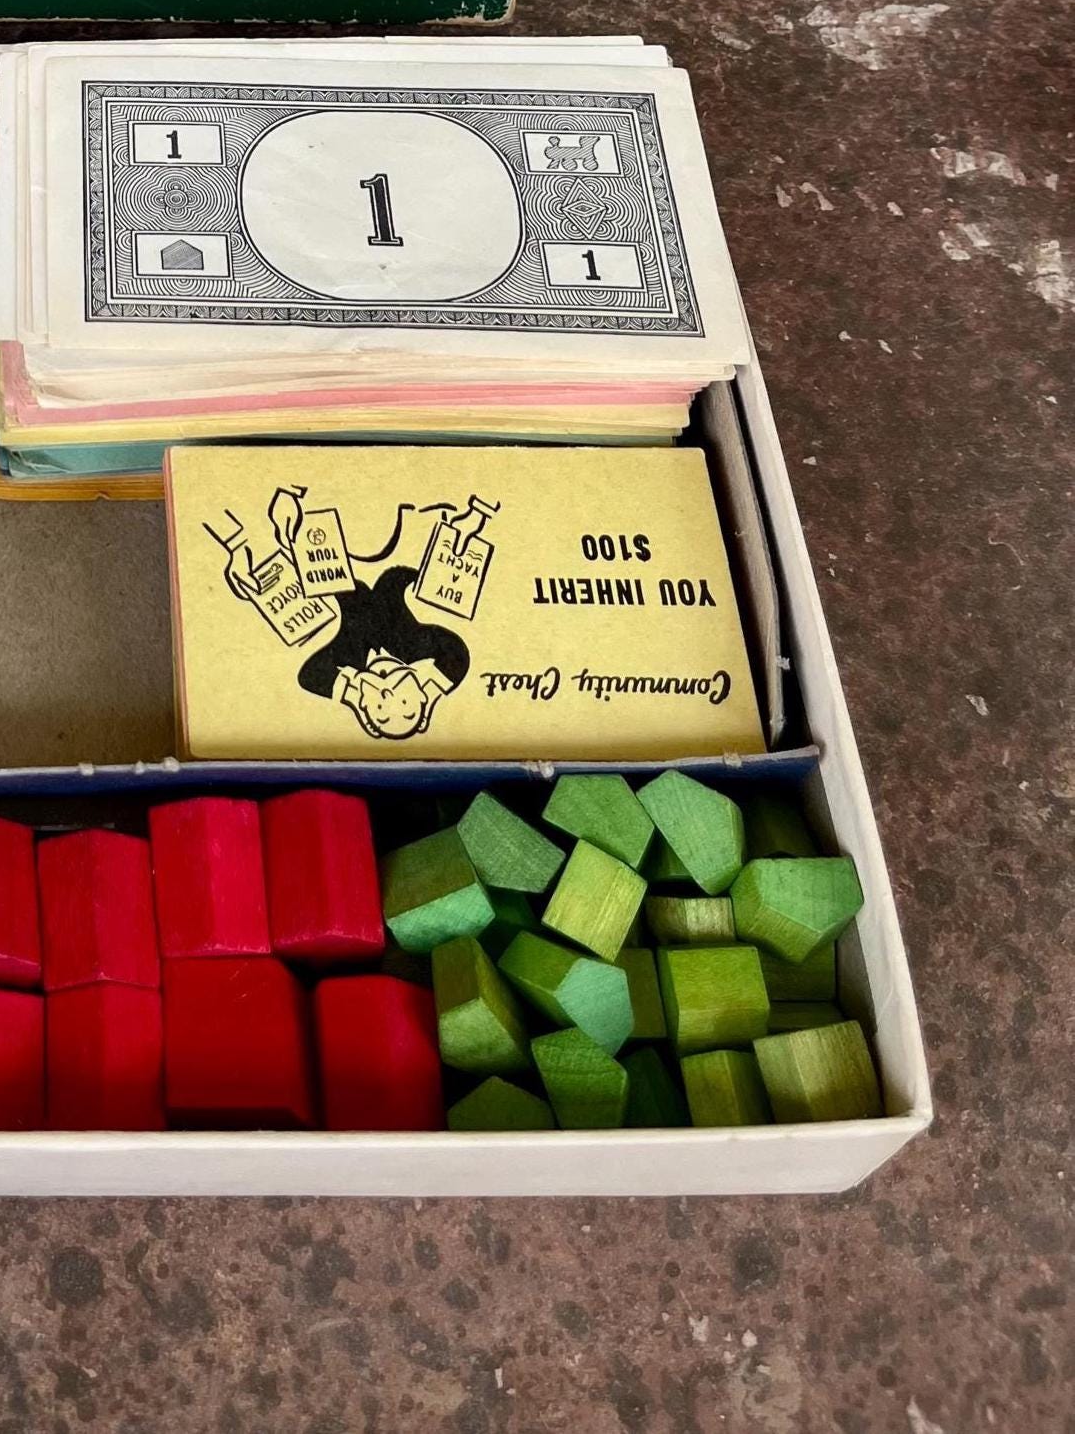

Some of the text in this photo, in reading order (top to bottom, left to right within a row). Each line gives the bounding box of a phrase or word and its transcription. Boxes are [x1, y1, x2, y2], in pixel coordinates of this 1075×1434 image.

[163, 129, 182, 160] 1
[358, 173, 406, 247] 1
[580, 249, 602, 281] 1
[306, 547, 338, 563] TOUR
[581, 534, 652, 562] $100
[307, 566, 348, 584] WORLD
[437, 552, 480, 578] YACHT
[436, 585, 464, 603] BUY
[533, 577, 717, 607] YOU INHERIT
[283, 599, 324, 633] ROLLS
[480, 667, 732, 705] Community Chest
